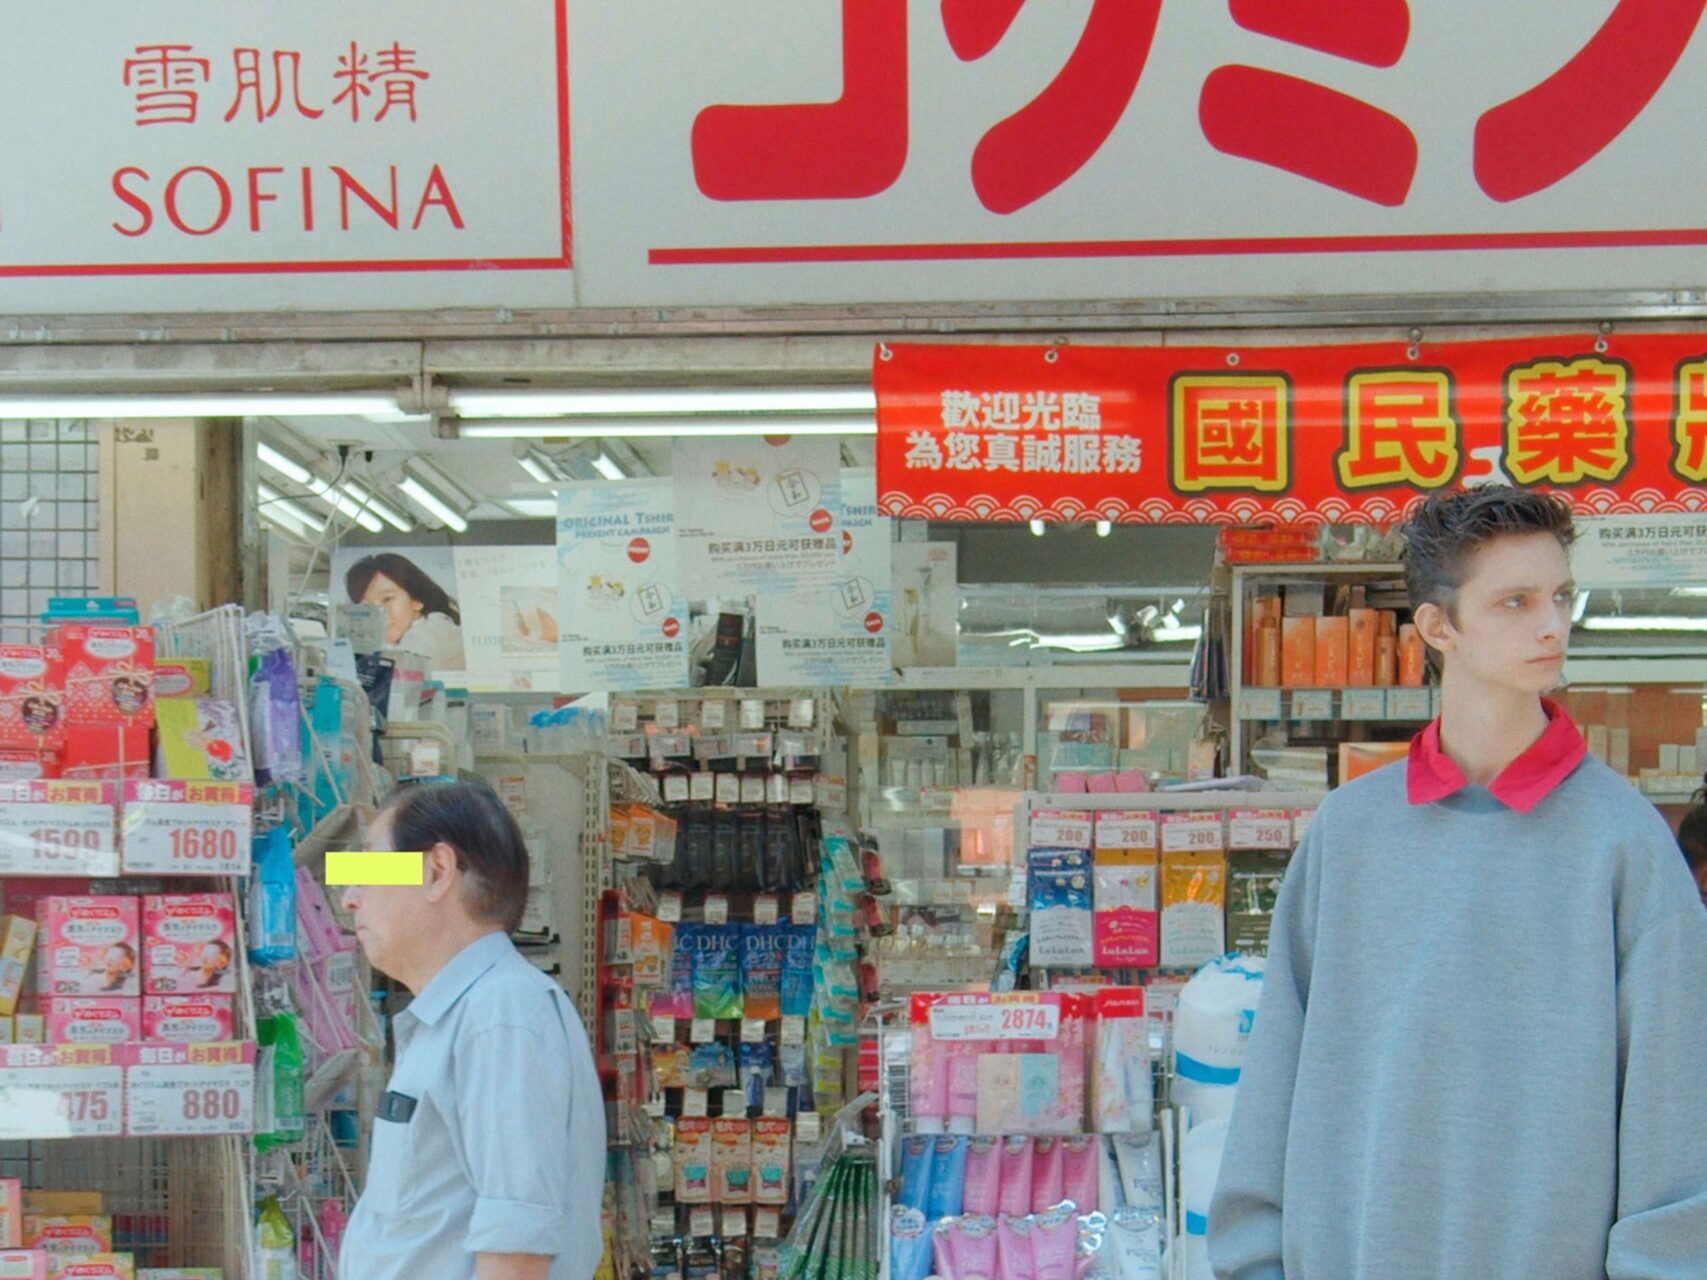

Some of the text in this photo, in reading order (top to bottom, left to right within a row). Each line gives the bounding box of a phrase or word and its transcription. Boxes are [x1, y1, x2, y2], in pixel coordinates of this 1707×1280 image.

[123, 41, 431, 126] 雪肌精
[111, 164, 465, 237] SOFINA
[940, 390, 1101, 430] 歡迎光臨
[905, 431, 1142, 473] 為您真誠服務
[563, 514, 630, 529] ORIGINAL
[574, 528, 615, 540] PRESENT
[616, 526, 671, 538] CAMPAIGN
[169, 827, 237, 859] 1680
[697, 935, 738, 950] DHC
[746, 935, 784, 950] DHC
[1002, 1009, 1046, 1030] 2874
[183, 1089, 240, 1120] 880
